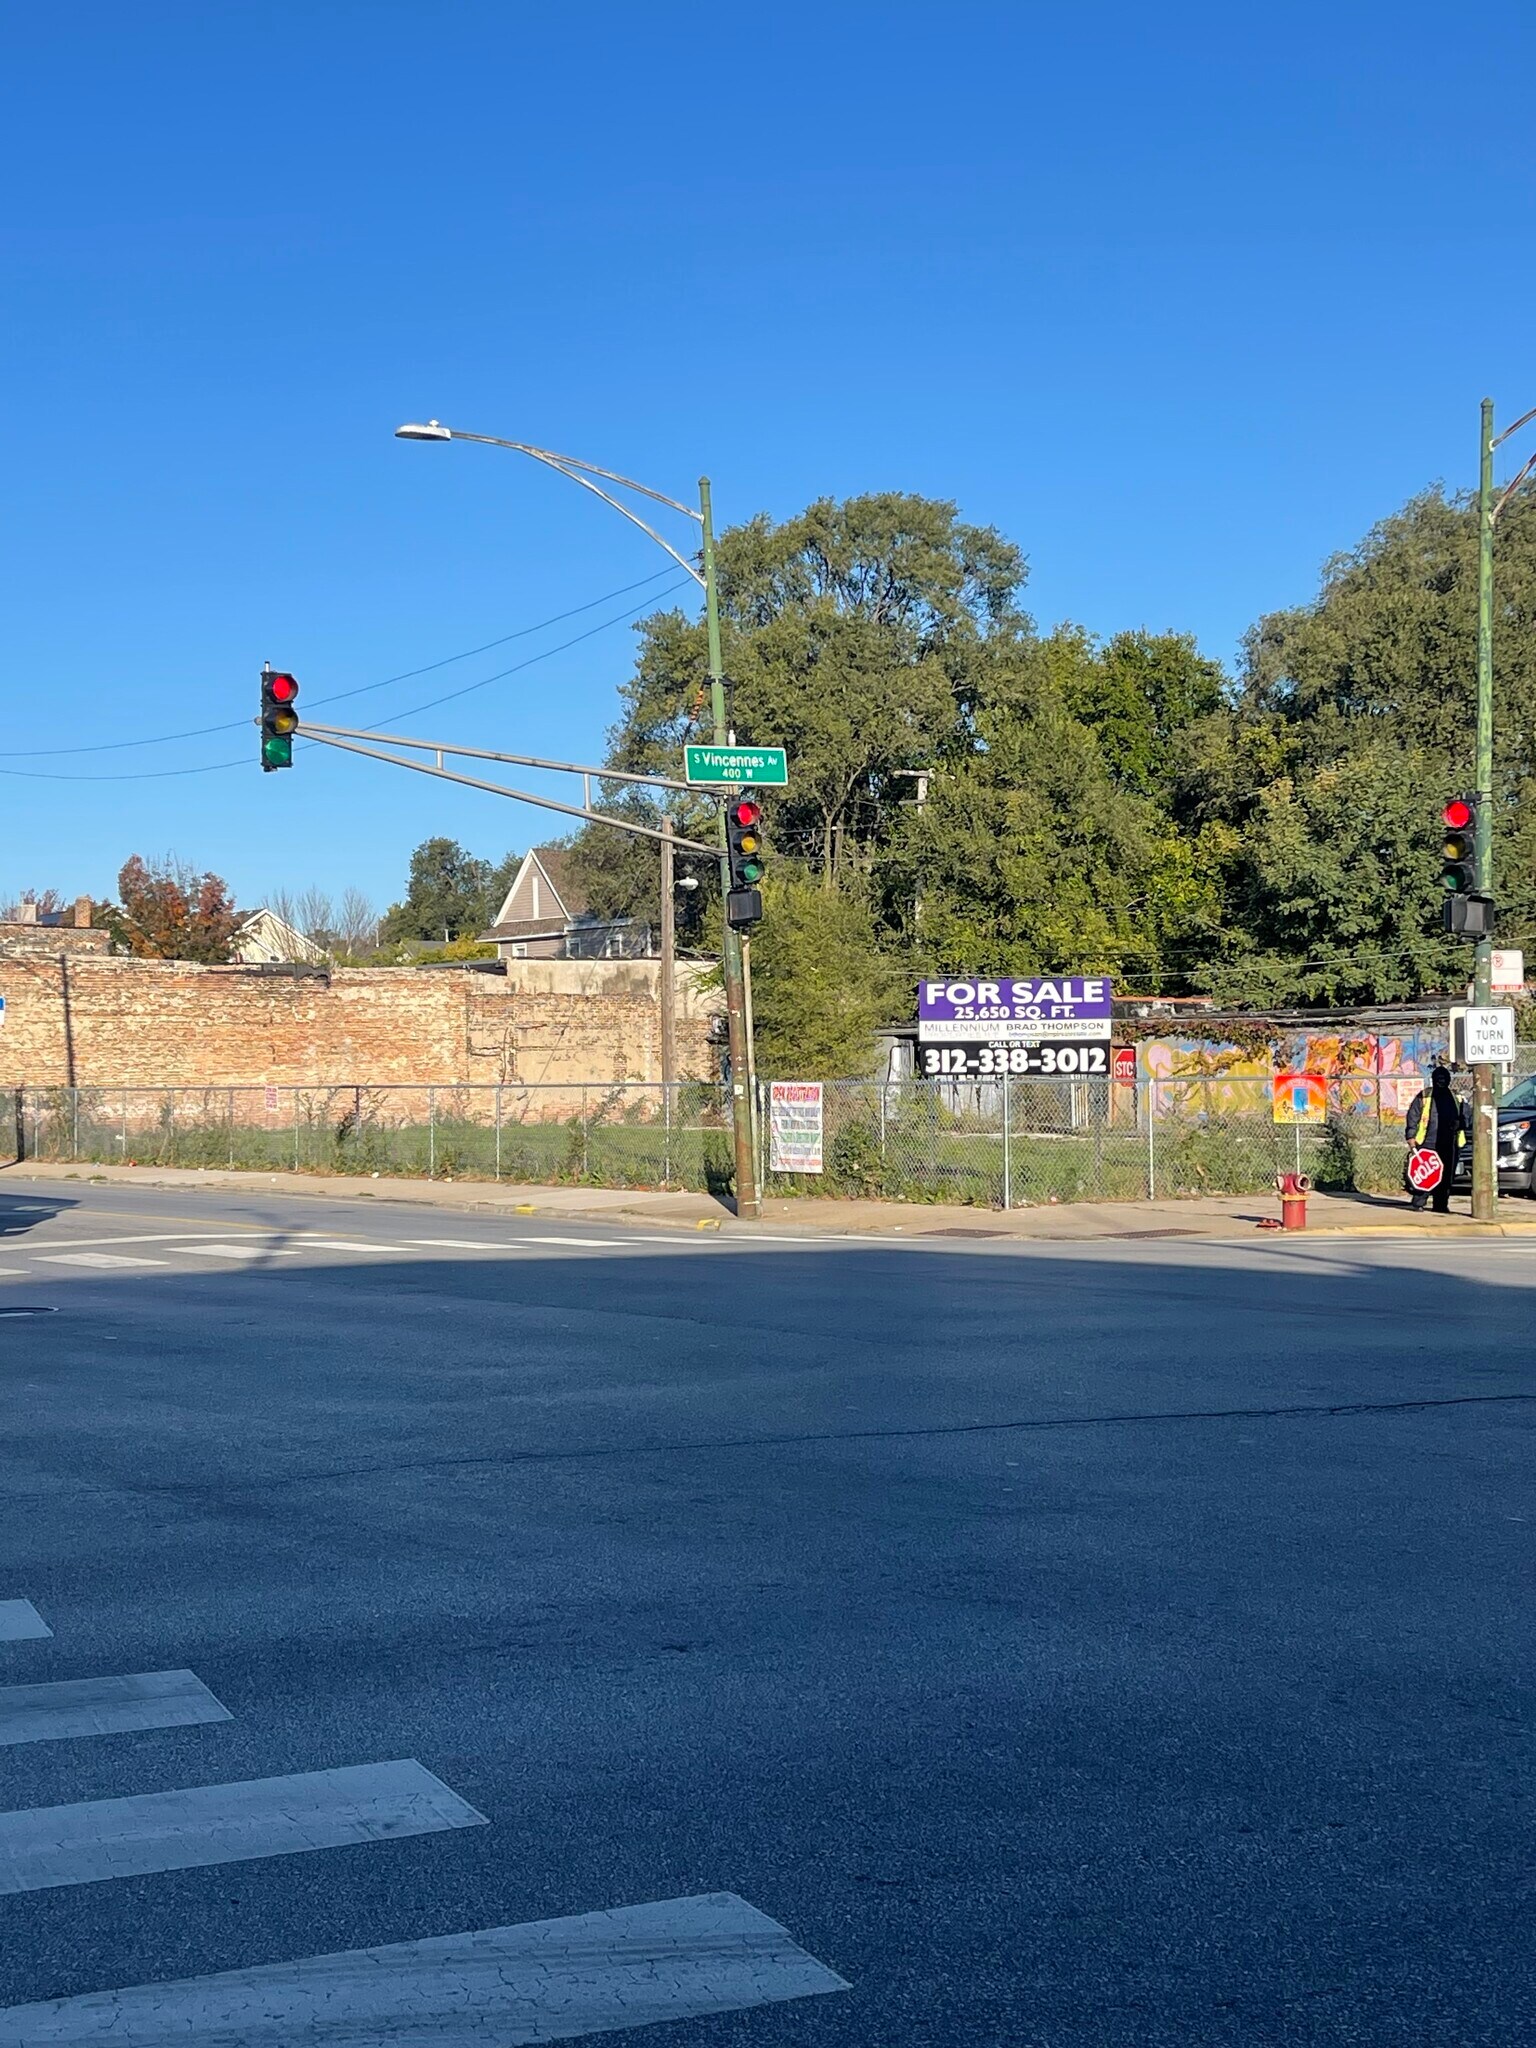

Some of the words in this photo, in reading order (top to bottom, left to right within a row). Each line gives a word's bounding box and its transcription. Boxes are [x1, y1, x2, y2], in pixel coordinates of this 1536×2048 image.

[694, 753, 700, 764] S
[702, 752, 765, 768] Vincennes
[767, 755, 778, 766] Av
[722, 768, 741, 779] 400
[745, 769, 753, 779] W
[926, 983, 1002, 1005] FOR
[1012, 981, 1104, 1004] SALE
[954, 1005, 1010, 1021] 25,650
[1014, 1005, 1046, 1020] SQ.
[1051, 1005, 1075, 1018] FT.
[1006, 1023, 1038, 1031] BRAD
[1041, 1021, 1104, 1031] THOMPSON
[1480, 1015, 1498, 1026] NO
[924, 1023, 1000, 1033] MILLENNIUM
[1476, 1030, 1504, 1040] TURN
[988, 1040, 1008, 1049] CALL
[1009, 1040, 1021, 1048] OR
[1022, 1040, 1041, 1048] TEXT
[1471, 1045, 1485, 1056] ON
[1490, 1044, 1509, 1055] RED
[925, 1047, 1107, 1074] 312-338-3012
[1413, 1155, 1440, 1185] STOP
